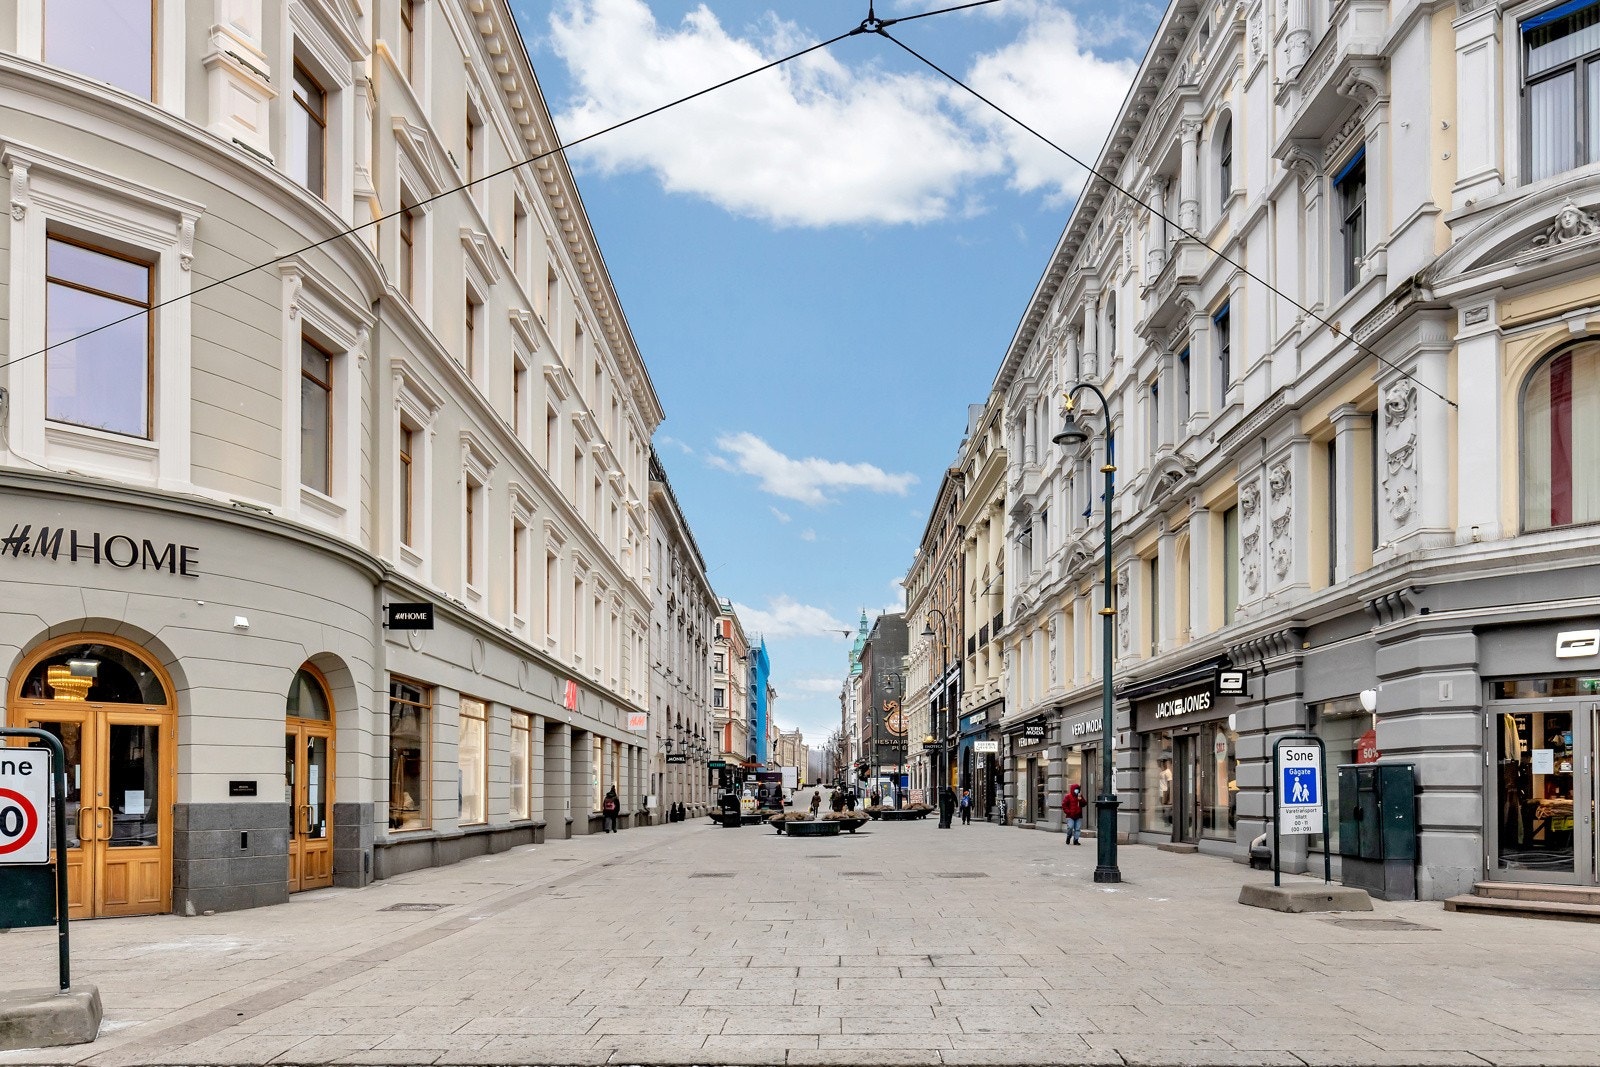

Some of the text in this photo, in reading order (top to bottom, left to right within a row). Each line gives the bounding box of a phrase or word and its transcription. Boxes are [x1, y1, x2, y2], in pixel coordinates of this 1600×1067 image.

[1, 523, 200, 578] H&M HOME
[1155, 691, 1210, 719] JACK JONES
[1071, 718, 1103, 736] VERO MODA
[1286, 749, 1314, 761] Sone
[1363, 747, 1379, 759] 50%
[1, 760, 33, 776] ne
[1289, 768, 1311, 777] Gågate
